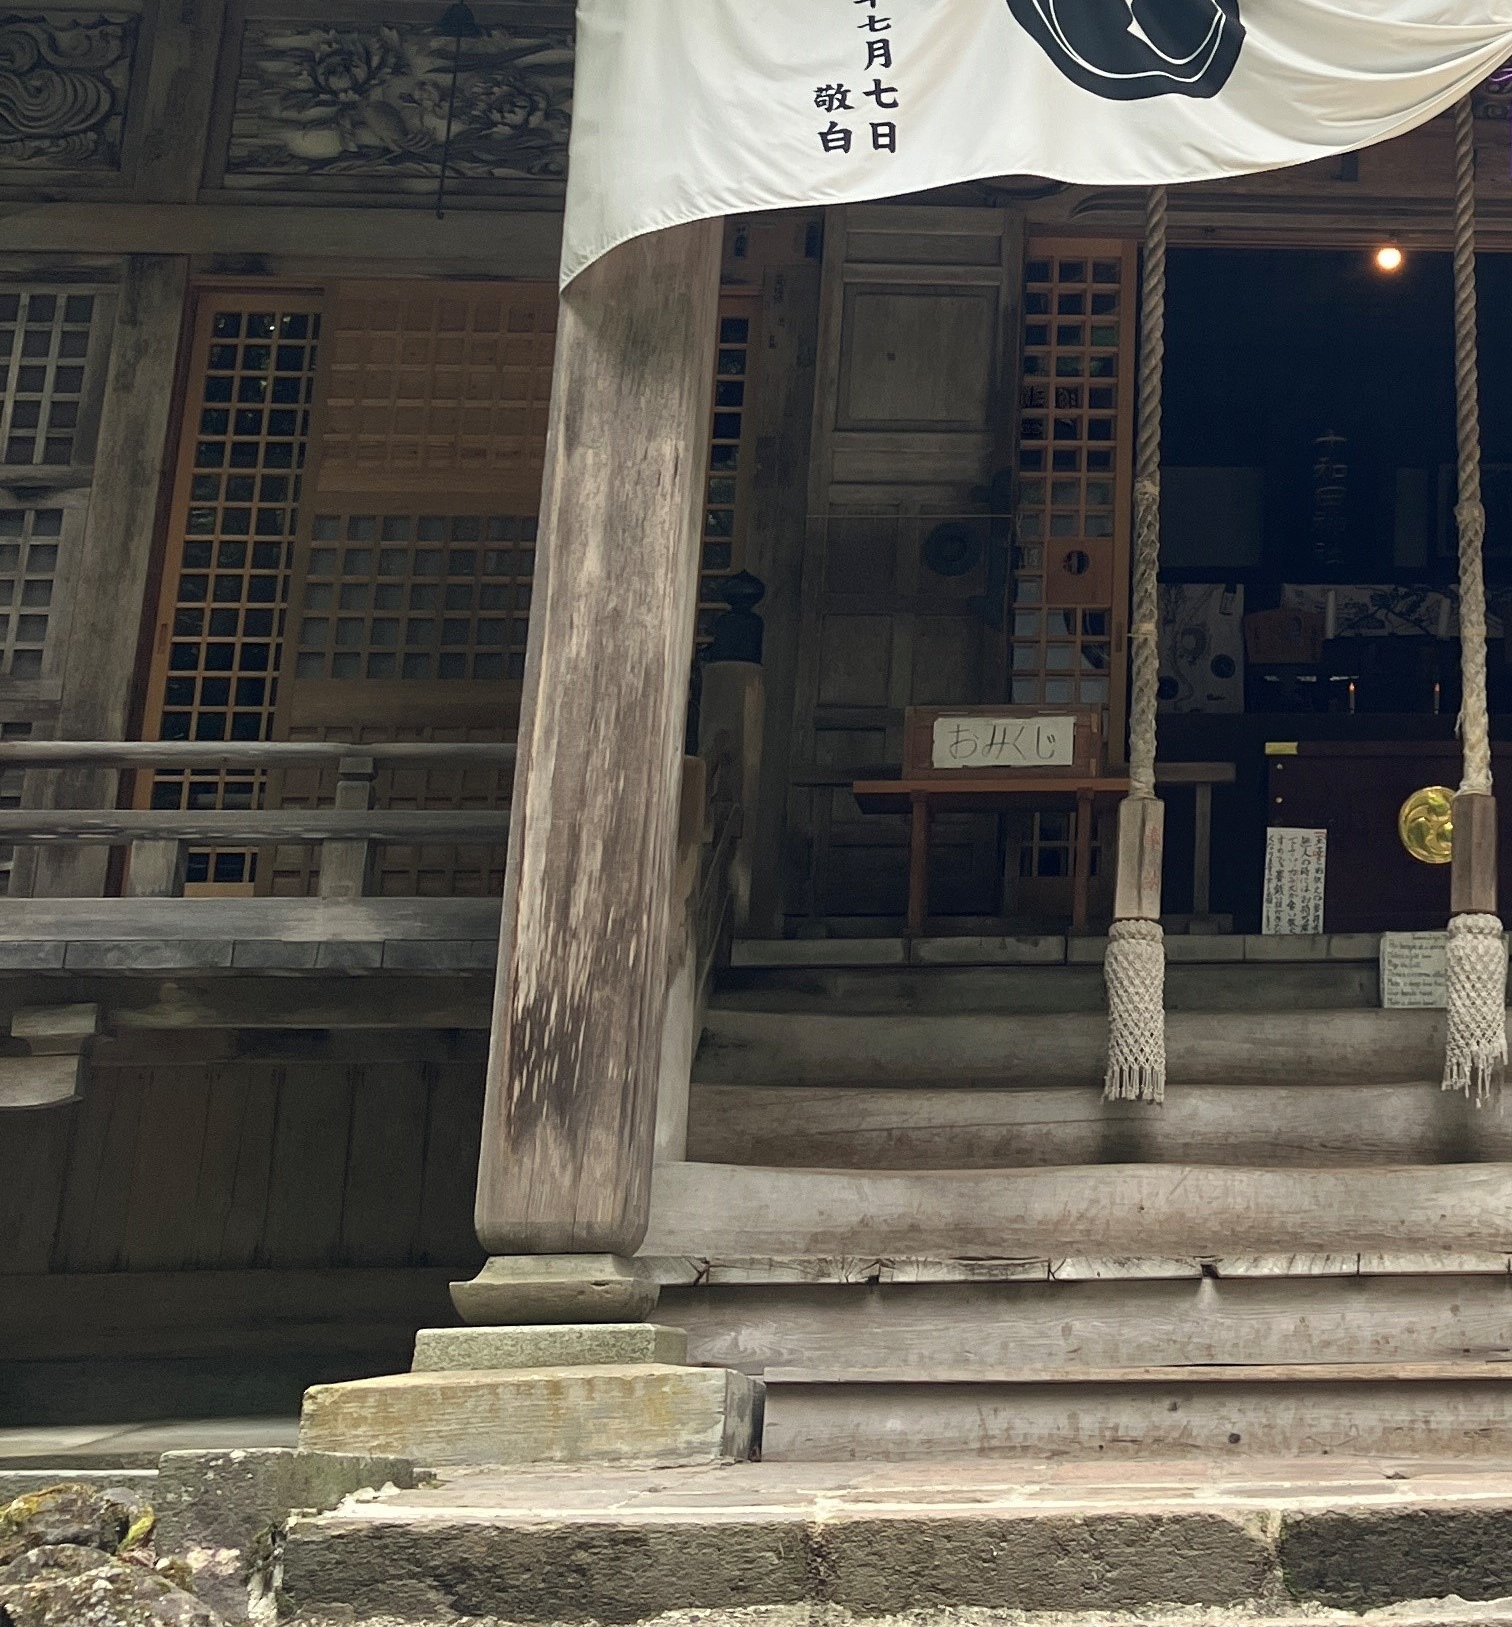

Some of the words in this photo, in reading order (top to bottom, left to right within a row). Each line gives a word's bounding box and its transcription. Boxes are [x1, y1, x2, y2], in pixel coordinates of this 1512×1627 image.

[812, 82, 856, 154] 敬白
[946, 722, 1057, 761] おみくじ
